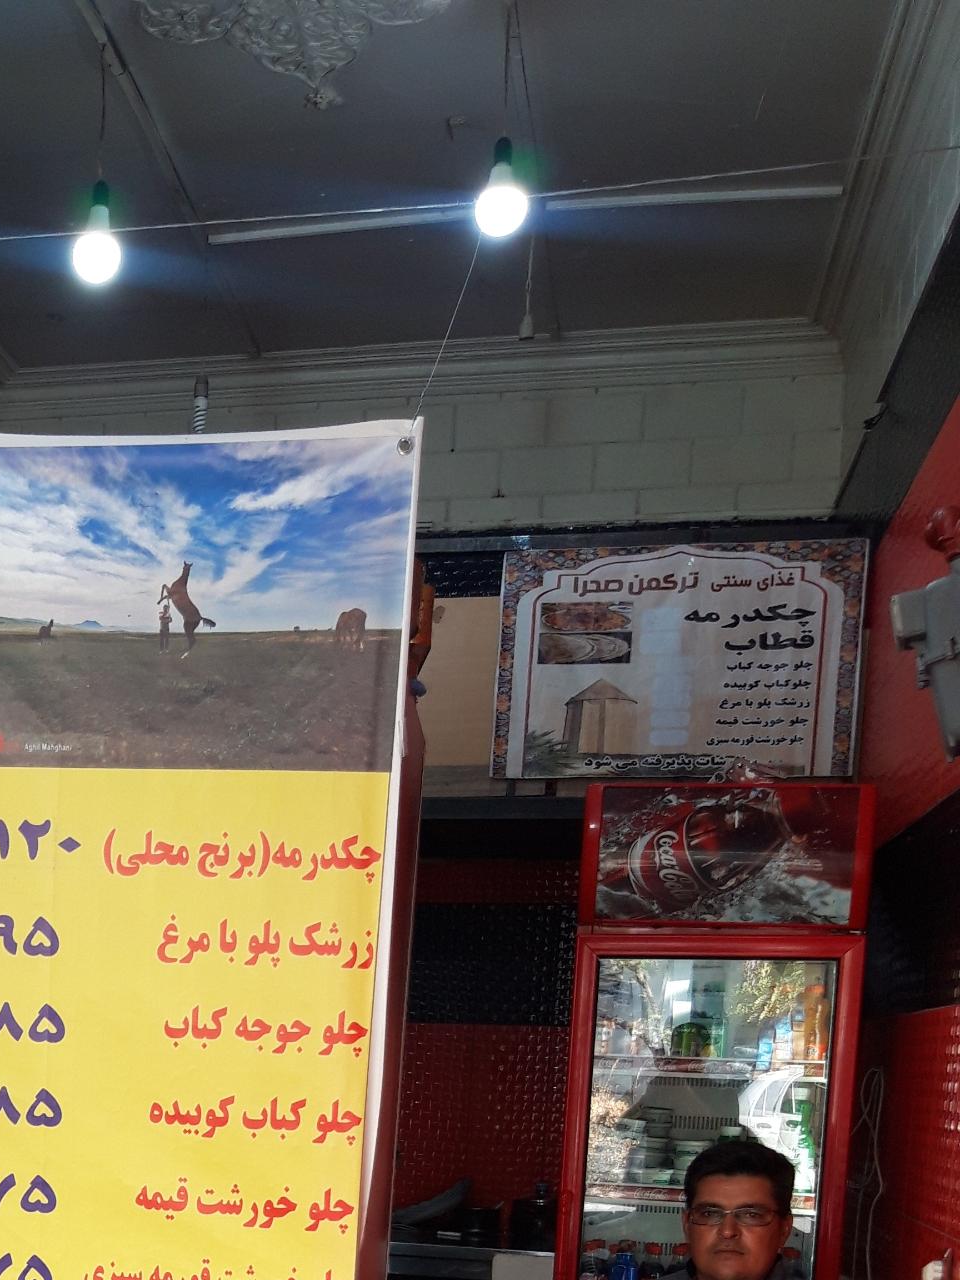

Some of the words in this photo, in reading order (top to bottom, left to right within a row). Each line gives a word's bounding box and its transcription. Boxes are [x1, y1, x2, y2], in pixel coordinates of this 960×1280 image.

[573, 576, 623, 597] صحرا
[628, 572, 699, 595] ترکمن
[711, 575, 751, 592] سنتی
[757, 572, 795, 591] غذای
[684, 603, 816, 627] چکدرمه
[725, 630, 815, 655] قطاب
[727, 661, 753, 672] کباب
[757, 662, 788, 671] جوجه
[793, 661, 813, 671] چلو
[723, 680, 761, 690] کوبیده
[719, 698, 741, 709] مرغ
[745, 699, 753, 708] با
[775, 698, 810, 708] زرشک
[716, 717, 739, 727] قیمه
[741, 717, 785, 727] خورشت
[788, 717, 809, 727] چلو
[585, 756, 612, 769] شود
[616, 758, 638, 769] می
[641, 755, 691, 770] پذیرفته
[156, 913, 210, 965] مرغ
[219, 918, 236, 964] با
[244, 919, 280, 968] پلو
[289, 921, 374, 969] زرشک
[163, 1006, 228, 1051] کباب
[235, 1014, 311, 1054] جوجه
[319, 1010, 368, 1057] چلو
[149, 1095, 236, 1139] کوبیده
[242, 1099, 307, 1142] کباب
[312, 1097, 363, 1145] چلو
[135, 1177, 189, 1221] قیمه
[196, 1183, 298, 1229] خورشت
[305, 1186, 354, 1235] چلو
